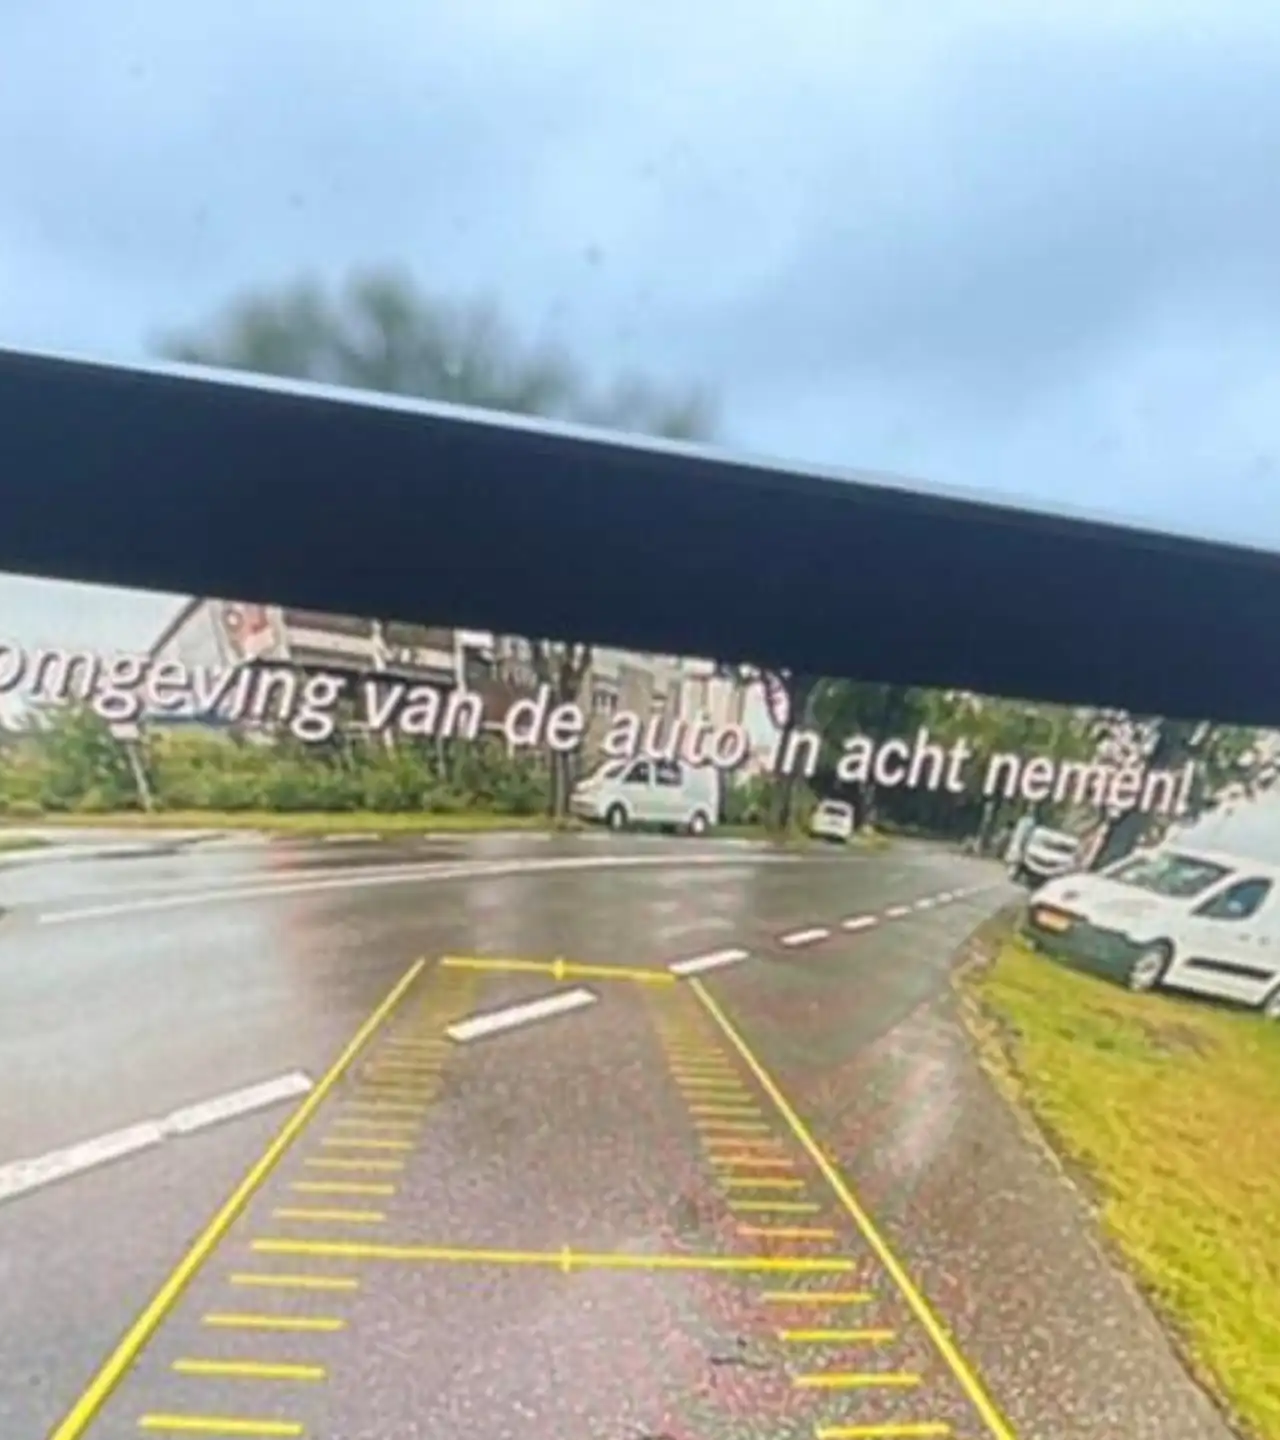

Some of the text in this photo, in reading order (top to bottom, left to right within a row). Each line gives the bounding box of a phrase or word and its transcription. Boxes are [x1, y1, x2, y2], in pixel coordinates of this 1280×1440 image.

[364, 676, 483, 741] van
[503, 684, 585, 752] de
[602, 703, 746, 770] auto
[837, 728, 972, 794] acht
